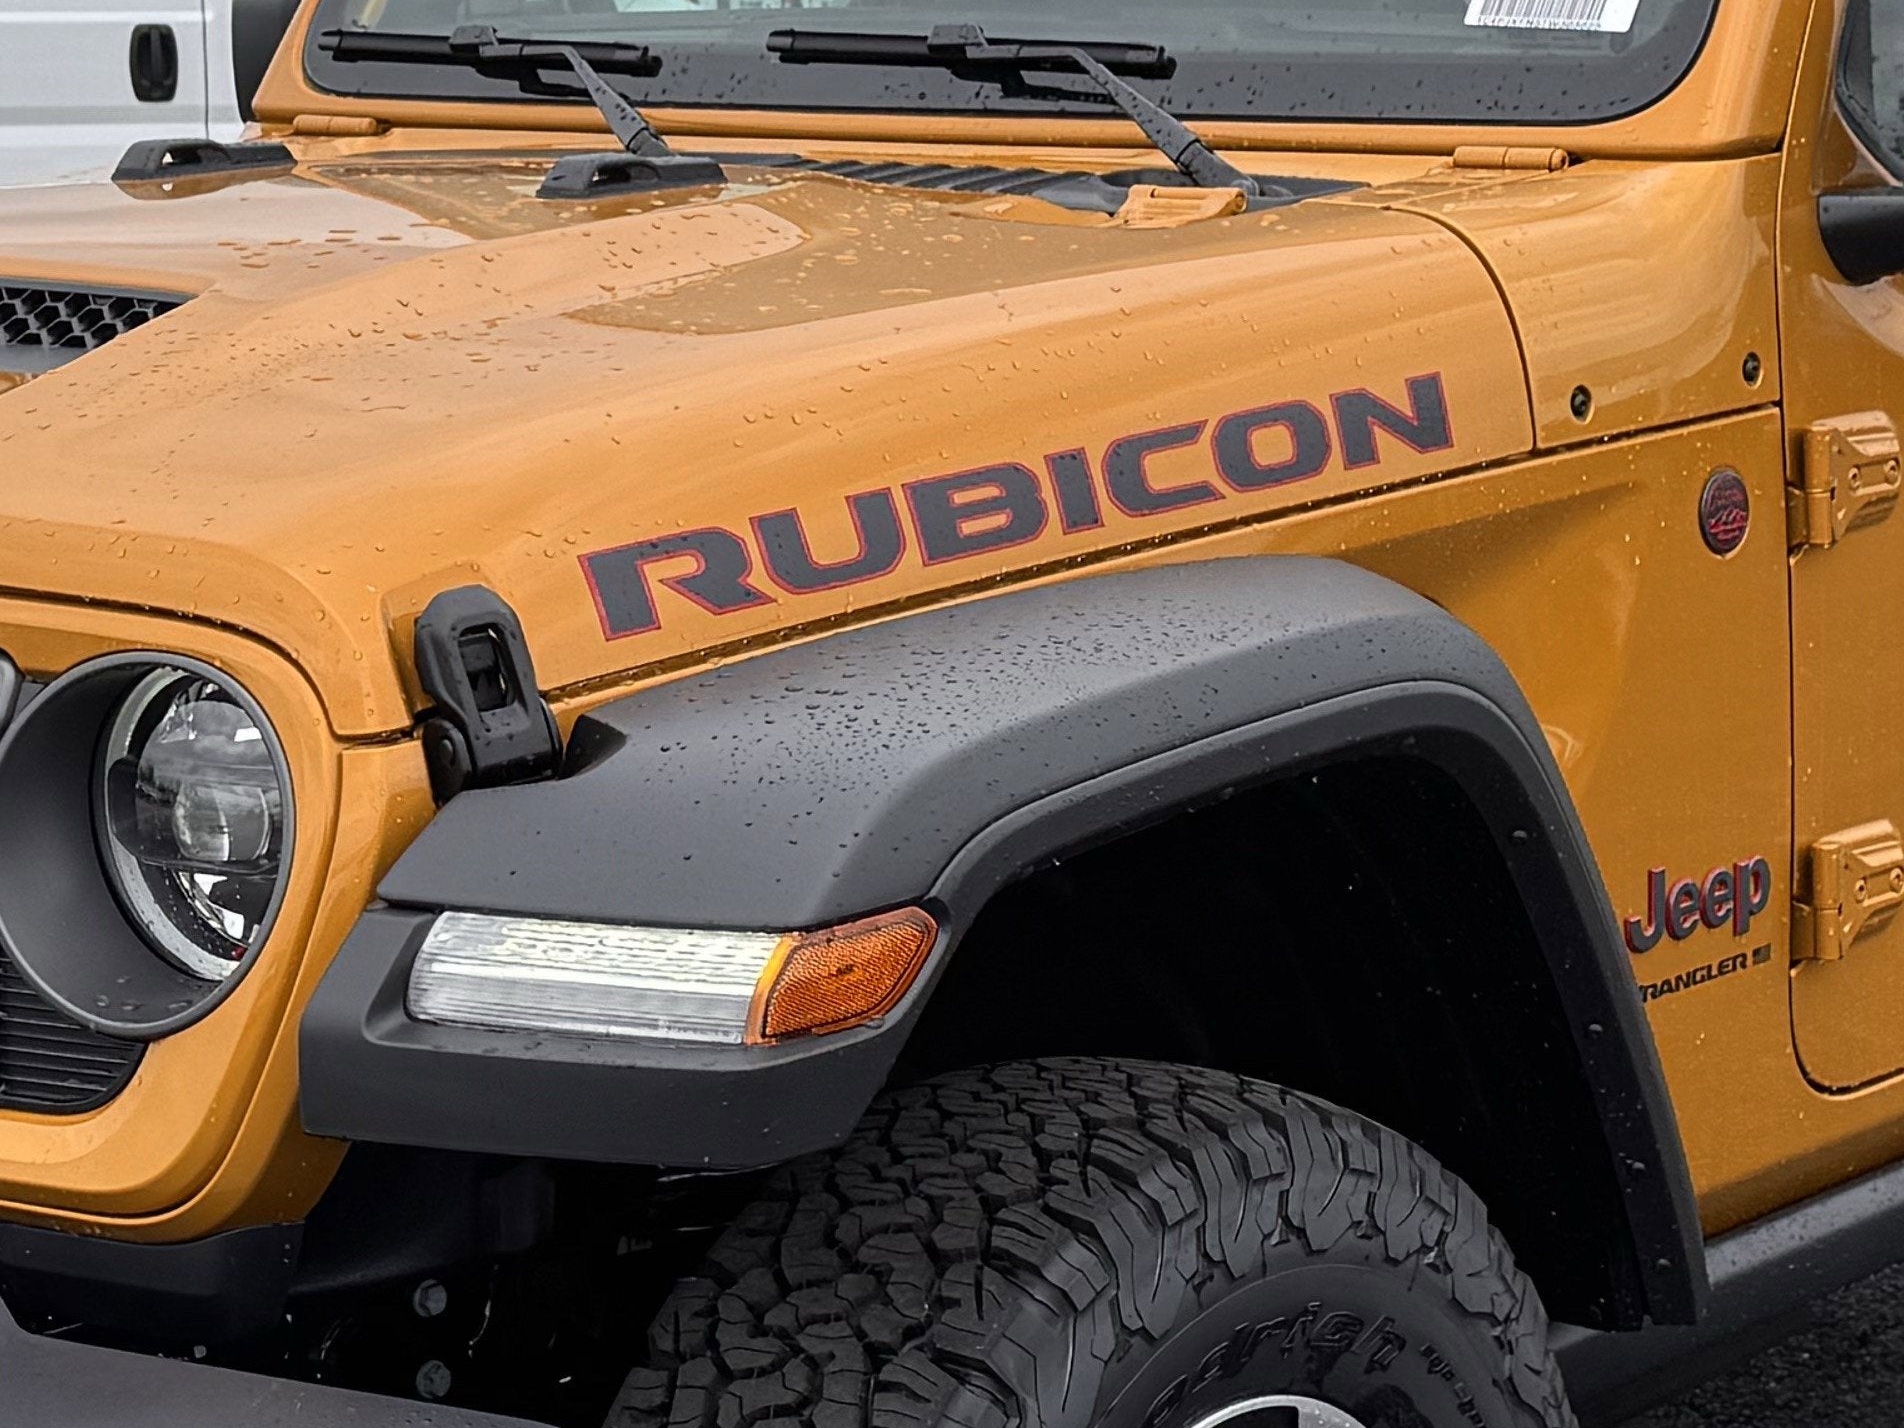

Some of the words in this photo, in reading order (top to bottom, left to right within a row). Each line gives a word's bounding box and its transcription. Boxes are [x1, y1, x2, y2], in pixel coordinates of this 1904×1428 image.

[578, 371, 1454, 642] RUBICON
[1624, 855, 1771, 954] Jeep
[1637, 952, 1748, 1003] RANGLER
